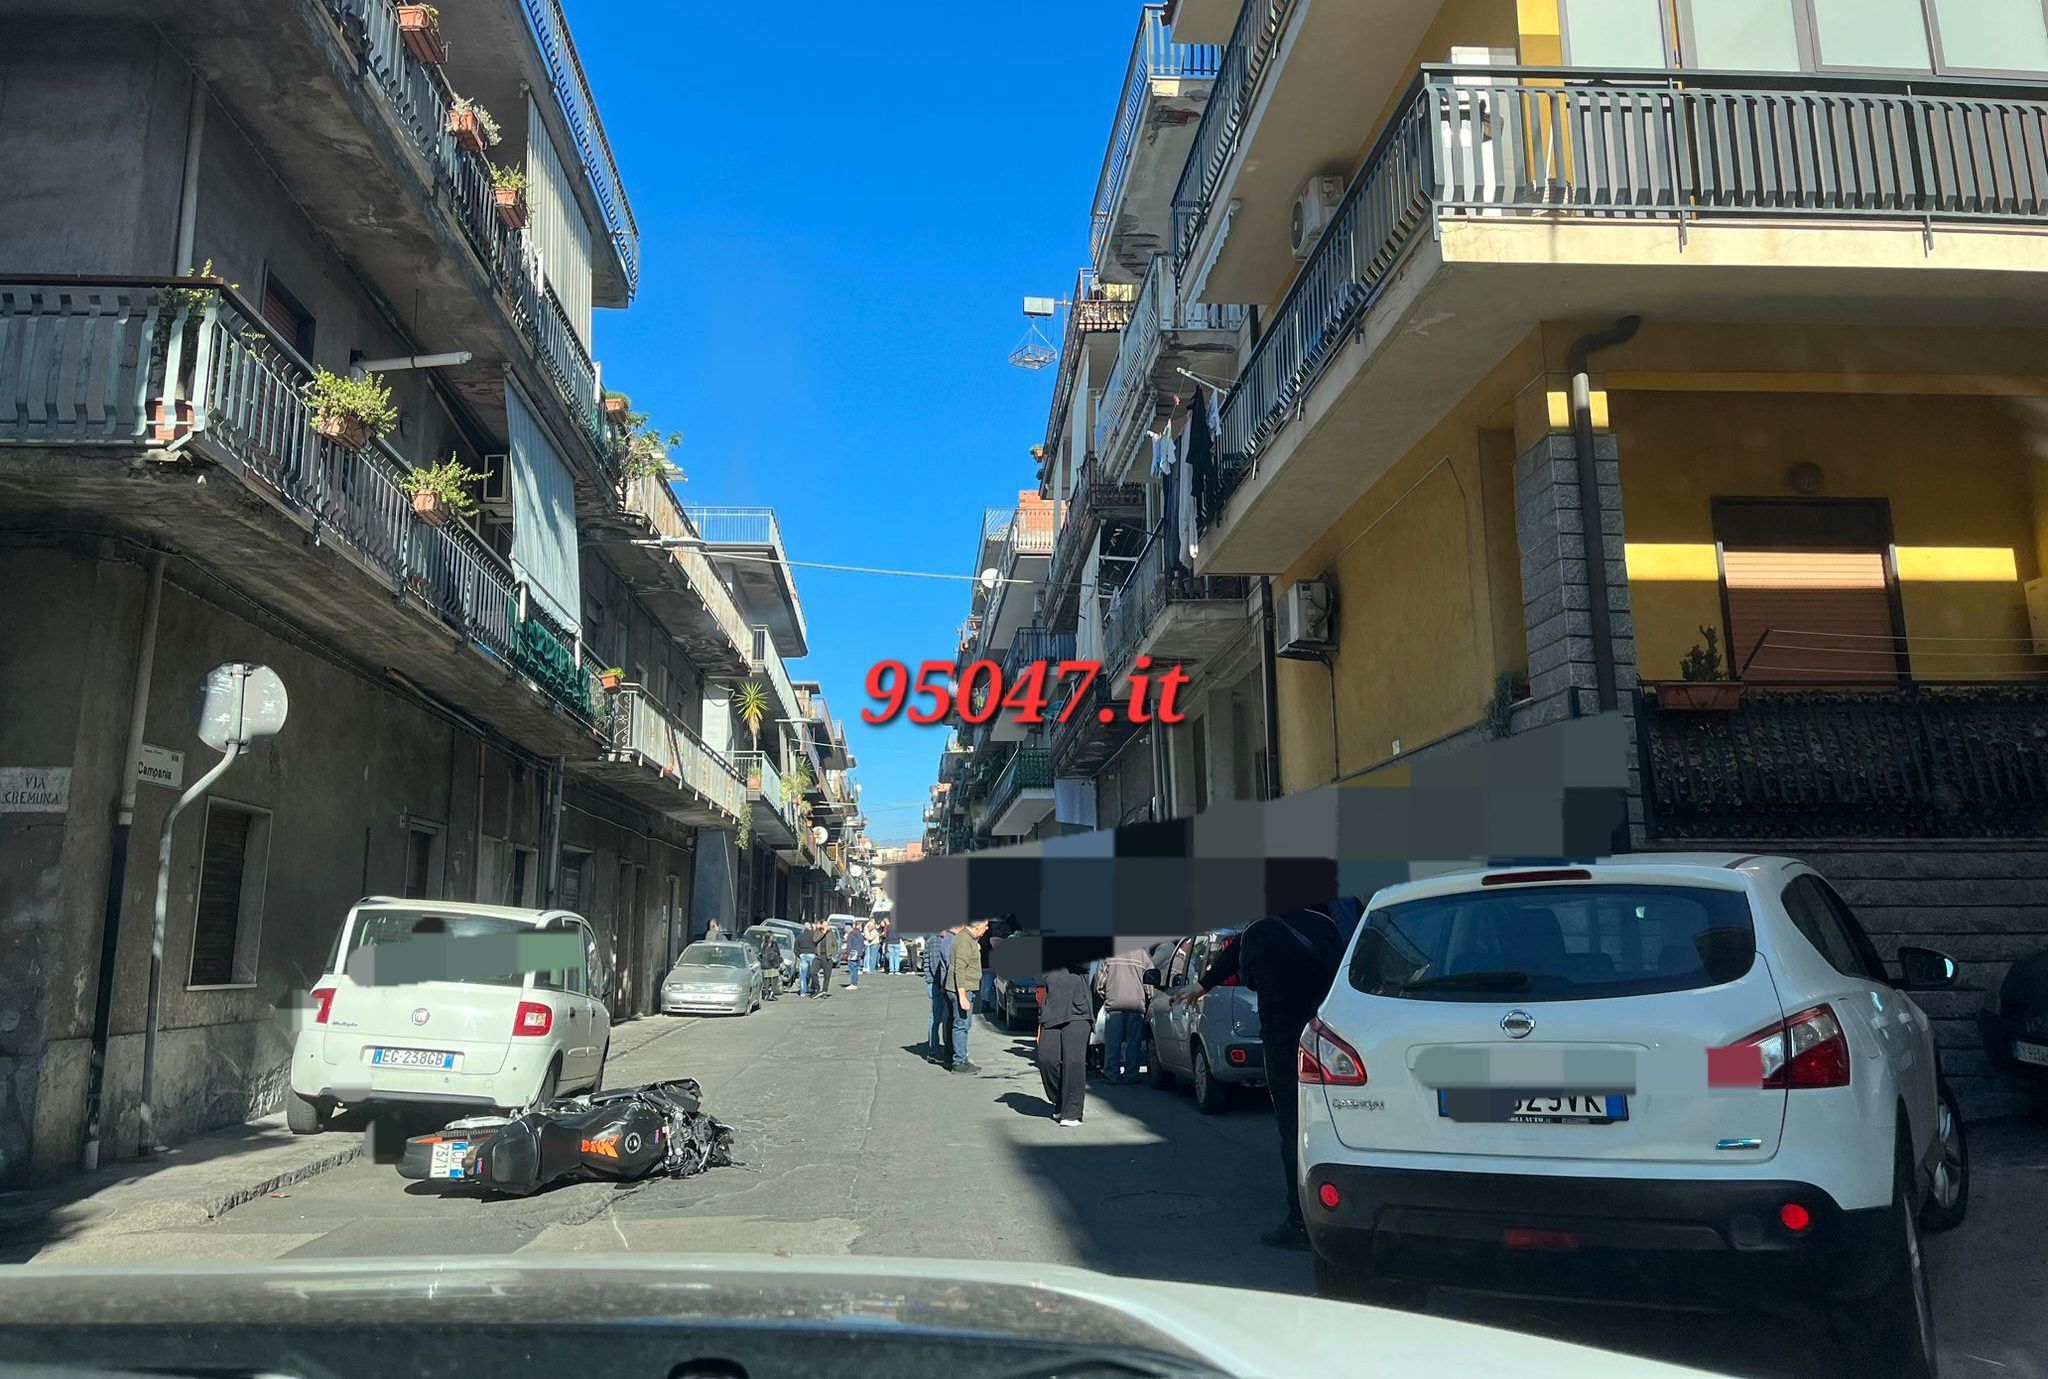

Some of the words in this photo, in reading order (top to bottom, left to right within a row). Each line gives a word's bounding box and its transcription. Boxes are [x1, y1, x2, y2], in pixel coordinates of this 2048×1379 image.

[138, 761, 172, 780] Campania
[26, 776, 46, 789] VIA
[433, 1144, 450, 1175] 73711
